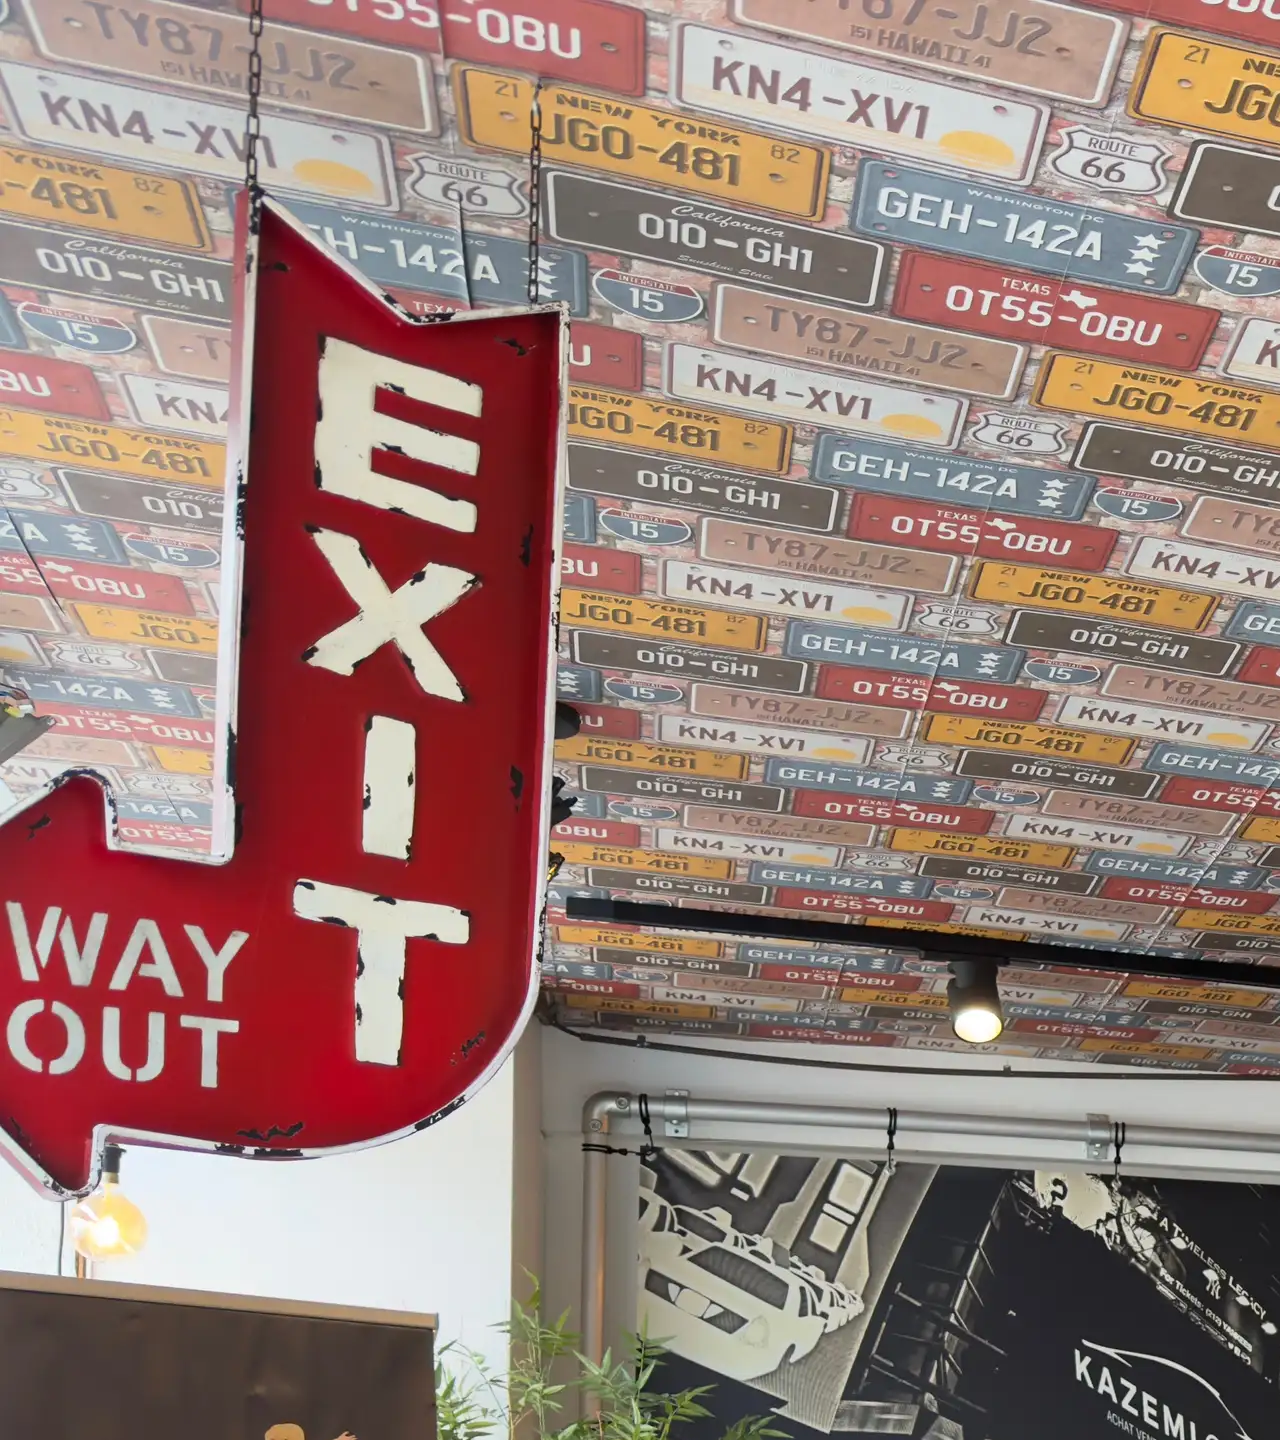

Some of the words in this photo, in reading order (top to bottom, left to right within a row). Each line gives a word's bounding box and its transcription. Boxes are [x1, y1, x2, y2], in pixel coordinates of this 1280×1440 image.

[711, 57, 932, 140] KN4-XV1
[438, 163, 491, 183] ROUTE
[441, 182, 489, 207] 66
[56, 321, 101, 344] 15
[1071, 361, 1095, 375] 21
[695, 366, 874, 420] KN4-XV1
[1119, 369, 1183, 387] NEW
[1195, 382, 1267, 404] YORK
[830, 449, 1018, 500] GEH-142A
[935, 508, 979, 522] TEXAS
[292, 335, 483, 1067] EXIT
[672, 835, 785, 857] KN4-XV1
[6, 901, 249, 1002] WAY
[6, 999, 239, 1088] OUT
[1107, 1410, 1134, 1435] ACHAT
